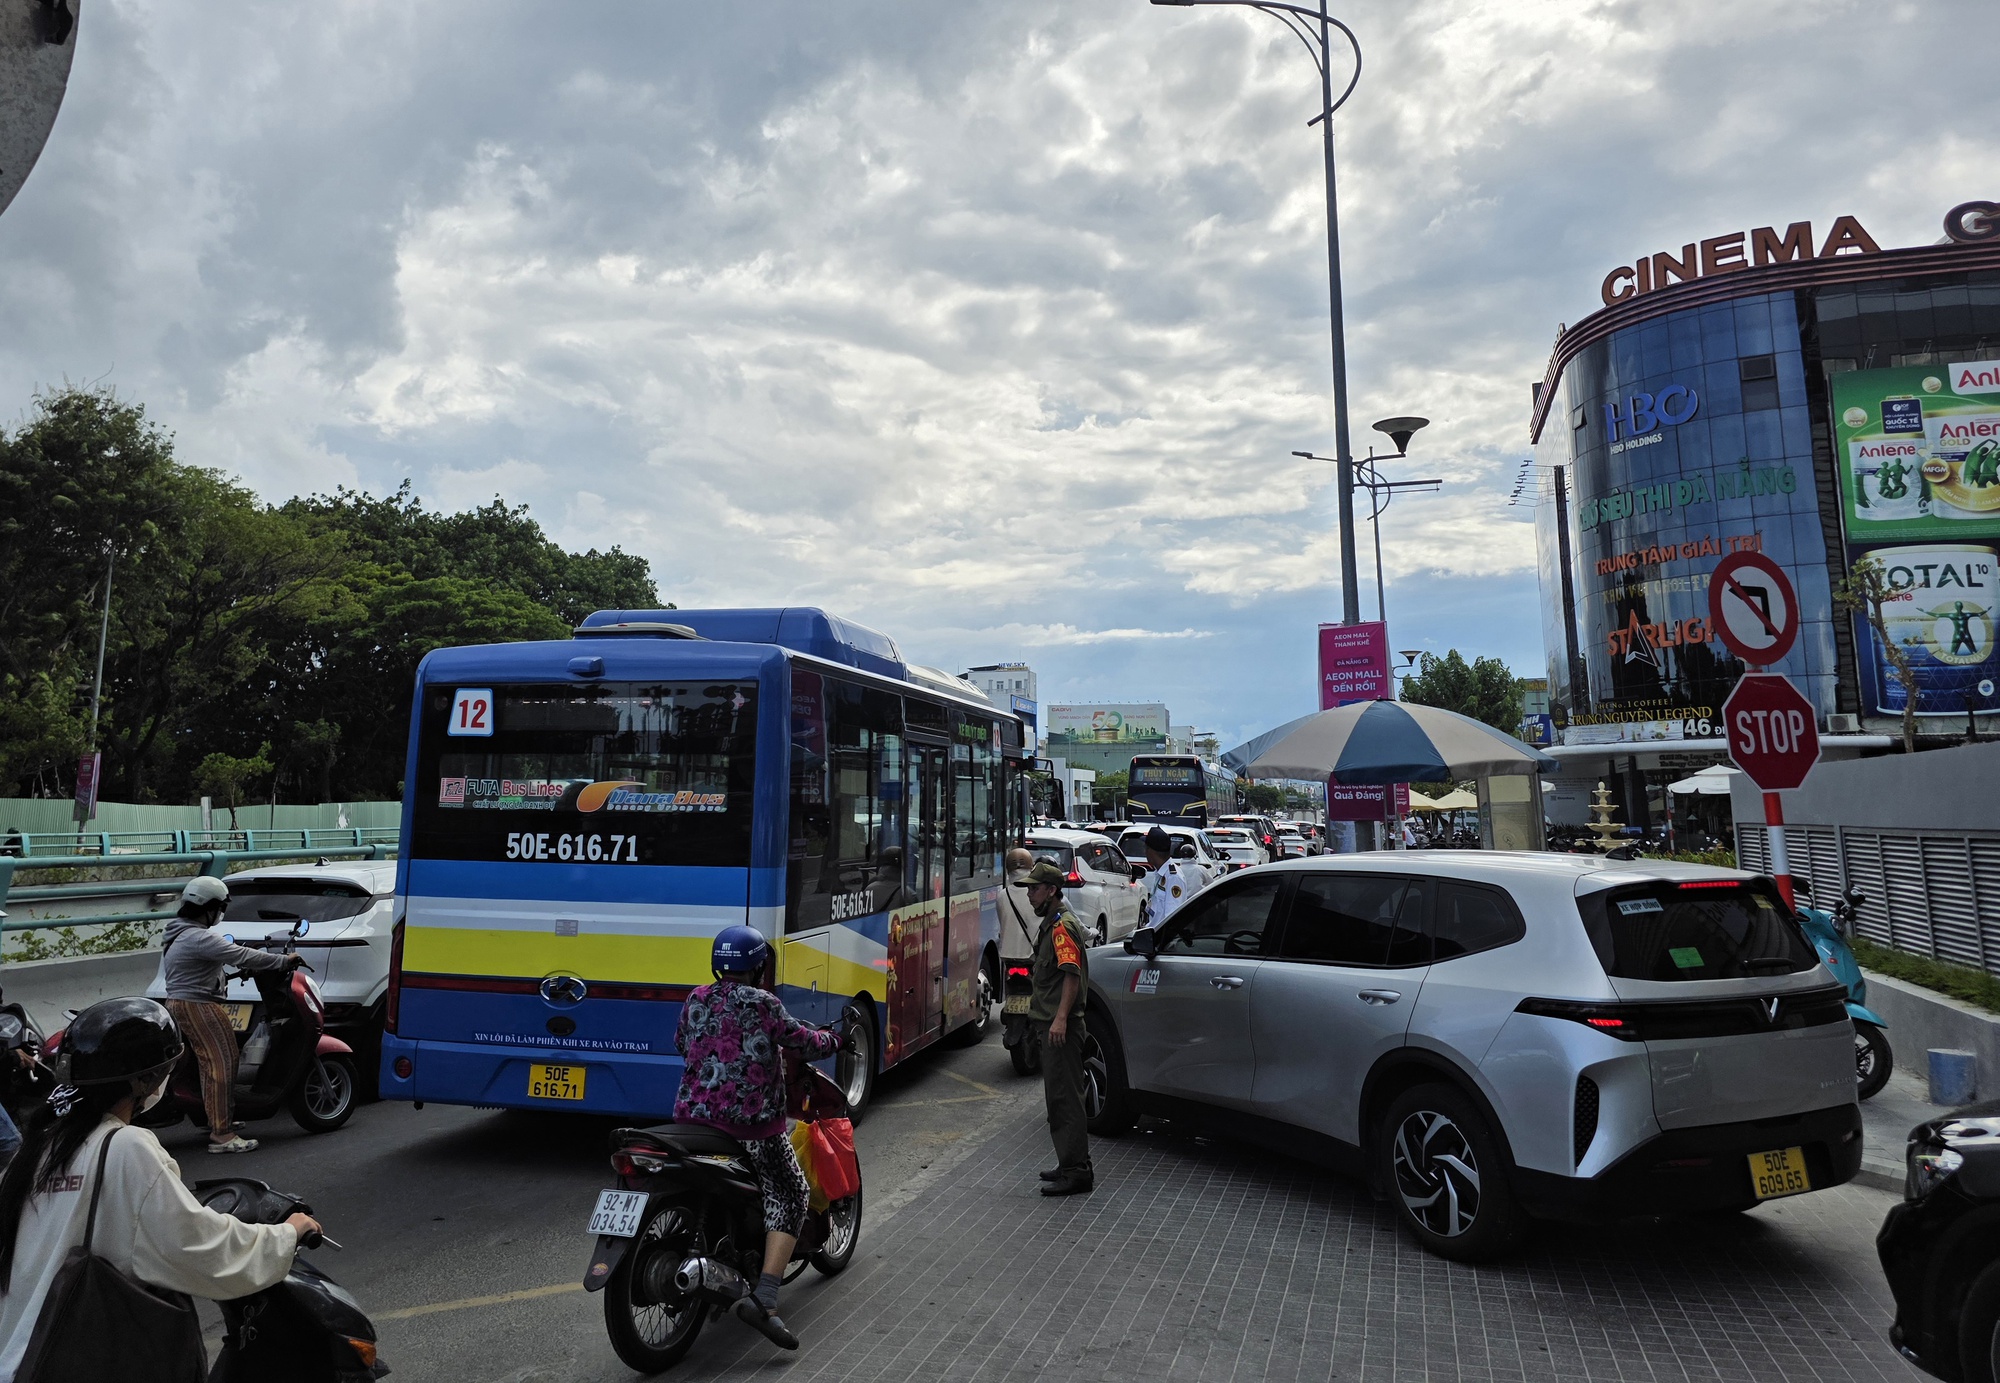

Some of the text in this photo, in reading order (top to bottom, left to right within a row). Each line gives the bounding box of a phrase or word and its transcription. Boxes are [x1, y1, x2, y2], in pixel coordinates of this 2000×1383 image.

[1601, 215, 1881, 306] CINEMA
[1602, 384, 1699, 443] HBO
[1885, 415, 1919, 425] QUỐC TẾ
[1610, 433, 1663, 455] HBO HOLDINGS
[1859, 443, 1916, 458] Anlene
[1939, 438, 1971, 447] GOLD
[1600, 488, 1634, 524] SIÊU
[1636, 482, 1672, 516] THỊ
[1675, 470, 1711, 507] ĐÀ
[1594, 552, 1638, 577] TRUNG
[1639, 543, 1678, 566] TÂM
[1691, 574, 1711, 592] TR
[1334, 633, 1352, 641] AEON
[1940, 652, 1986, 665] TOTALMAX
[1325, 669, 1383, 681] AEON MALL
[1332, 679, 1376, 693] ĐẾN RỒI!
[1633, 698, 1673, 708] COFFEE!
[458, 699, 488, 729] 12
[1092, 711, 1122, 729] 50
[1571, 706, 1713, 726] TRUNG NGUYÊN LEGEND
[1684, 718, 1711, 736] 46
[1714, 725, 1725, 735] ĐI
[1736, 708, 1804, 755] STOP
[993, 729, 999, 748] 12
[466, 778, 564, 797] FUTA Bus Lines
[1334, 791, 1384, 801] Quá Đáng!
[472, 798, 489, 809] CHẤT
[490, 799, 514, 811] LƯỢNG
[523, 801, 543, 809] DANH
[606, 804, 651, 812] Danang
[657, 803, 694, 813] Urban
[505, 832, 638, 862] 50E-616.71
[830, 890, 874, 920] 50E-616.71
[1620, 900, 1660, 912] XE HỢP ĐỒNG
[1136, 968, 1161, 985] NASCO
[222, 1004, 240, 1017] 3H
[475, 1033, 489, 1042] XIN
[490, 1032, 503, 1042] LỖI
[505, 1032, 516, 1043] ĐÃ
[517, 1034, 535, 1044] LÀM
[562, 1038, 577, 1047] KHI
[578, 1039, 590, 1048] XE
[592, 1040, 603, 1049] RA
[604, 1039, 623, 1050] VÀO
[624, 1041, 649, 1052] TRẠM
[545, 1066, 570, 1082] 50E
[533, 1081, 577, 1098] 616.71
[1763, 1151, 1790, 1172] 50E
[1759, 1170, 1803, 1194] 609.65
[591, 1213, 636, 1234] 034.54
